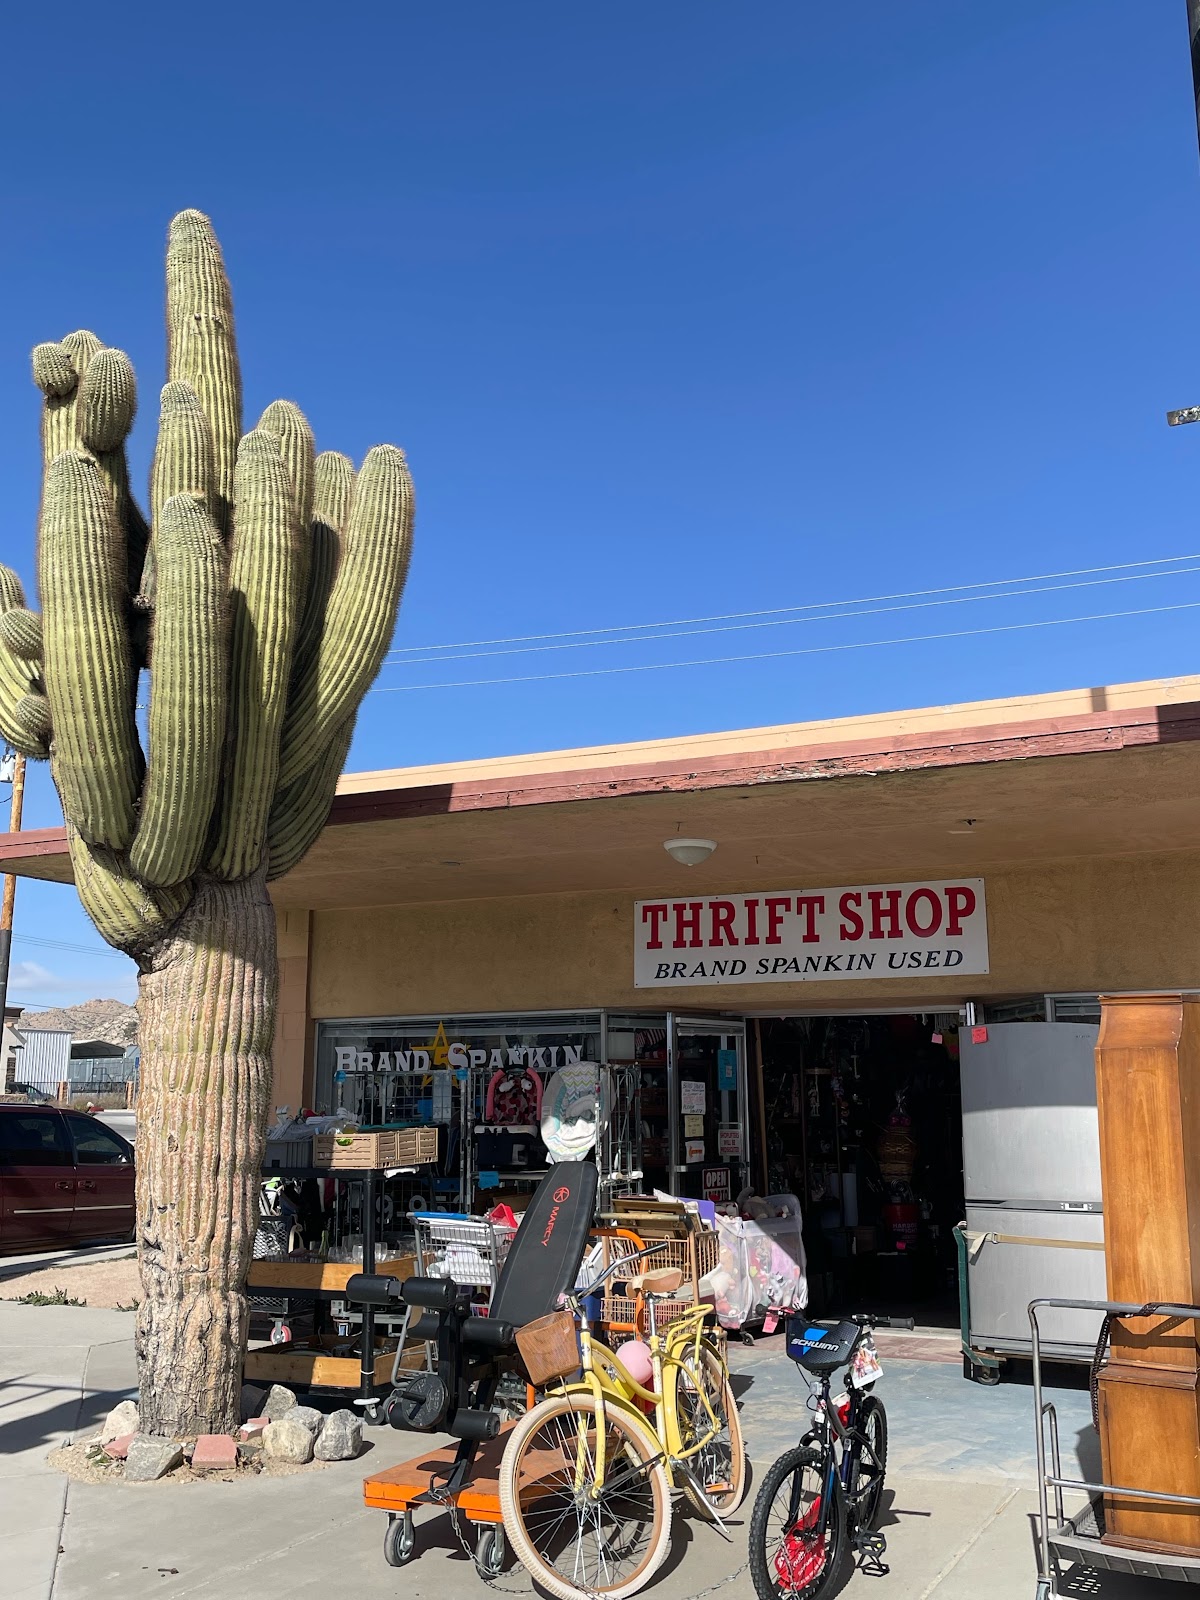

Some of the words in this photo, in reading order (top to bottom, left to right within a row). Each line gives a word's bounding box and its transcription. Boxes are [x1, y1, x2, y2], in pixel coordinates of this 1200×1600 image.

[642, 896, 825, 949] THRIFT
[839, 886, 976, 941] SHOP
[654, 959, 747, 979] BRAND
[755, 953, 877, 975] SPANKIN
[887, 949, 964, 970] USED
[335, 1046, 430, 1072] BRAND
[449, 1043, 583, 1070] SPANKIN
[706, 1171, 727, 1188] OPEN
[541, 1206, 560, 1247] MARCY
[790, 1338, 840, 1352] SCHWINN
